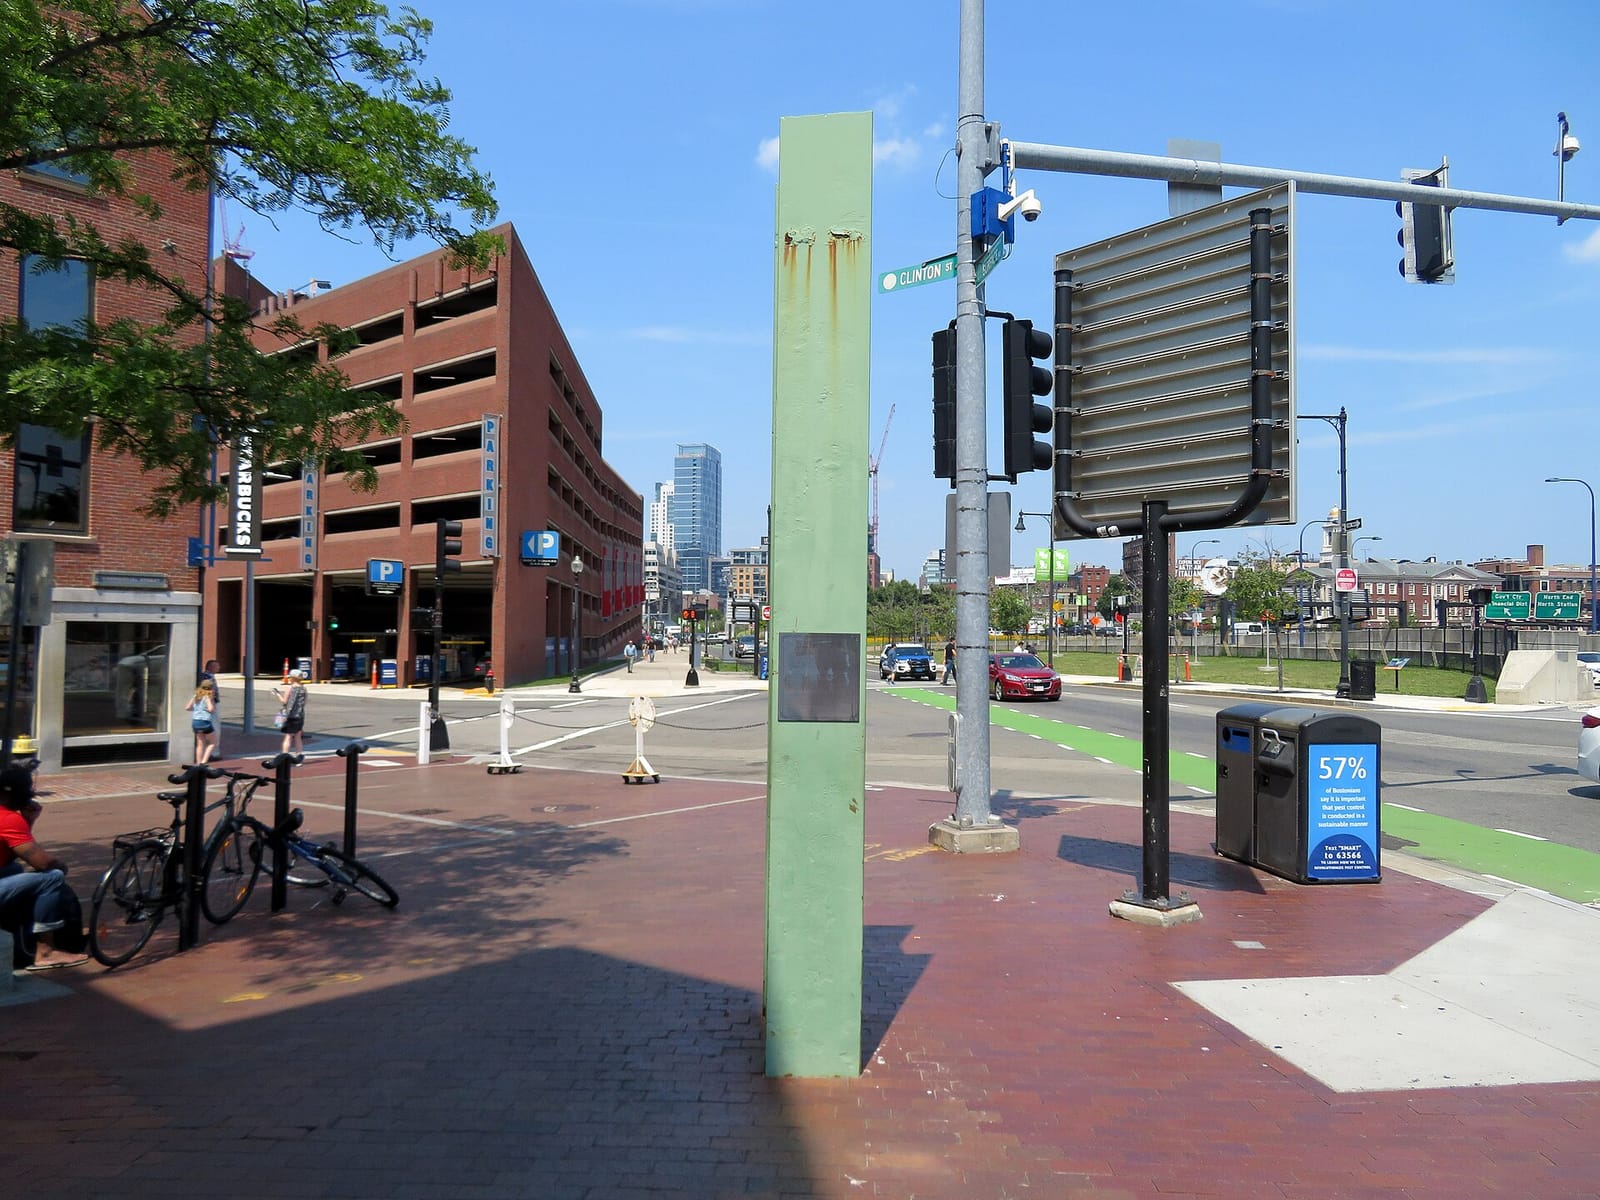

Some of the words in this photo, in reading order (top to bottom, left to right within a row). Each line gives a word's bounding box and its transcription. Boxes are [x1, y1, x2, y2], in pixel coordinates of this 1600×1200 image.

[900, 264, 941, 285] CLINTON
[945, 262, 953, 272] ST
[486, 420, 495, 549] PARKING
[537, 533, 554, 556] P
[380, 562, 394, 581] P
[1319, 757, 1367, 779] 57%
